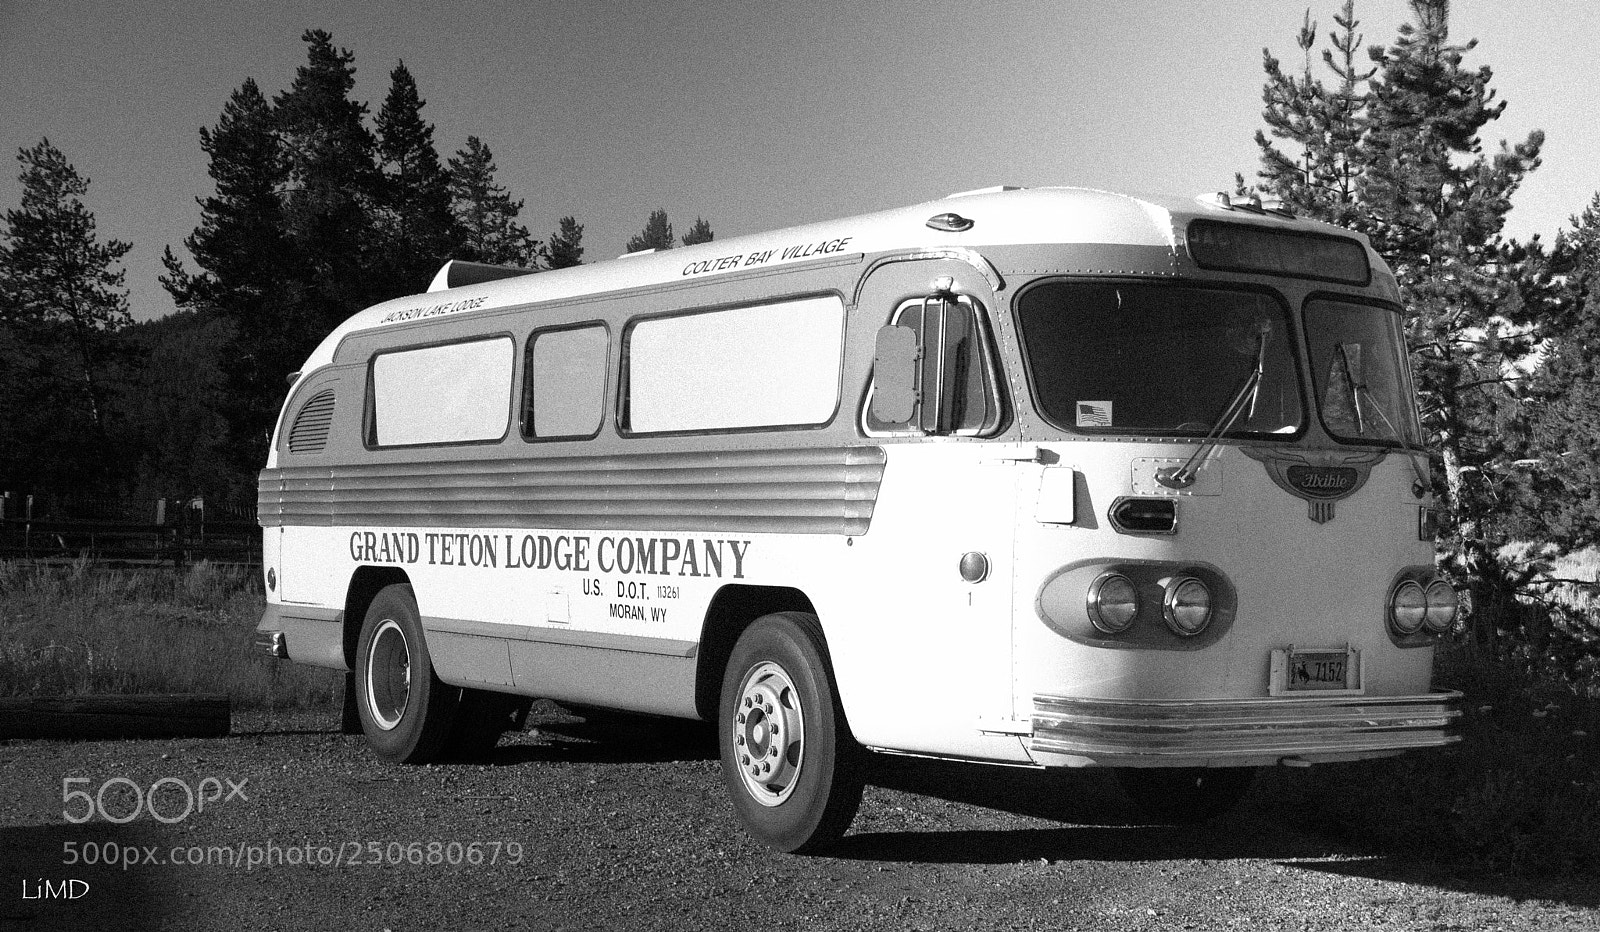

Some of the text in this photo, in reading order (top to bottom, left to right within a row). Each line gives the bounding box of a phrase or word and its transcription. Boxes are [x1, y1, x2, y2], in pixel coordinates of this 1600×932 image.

[682, 237, 853, 276] COLTER BAY VILLAGE
[423, 302, 452, 317] LAKE
[450, 296, 489, 313] LODGE
[350, 531, 751, 579] GRAND TETON LODGE COMPANY
[583, 578, 680, 600] U.S. D.O.T. 113261
[609, 603, 667, 624] MORAN, WY
[1315, 662, 1342, 682] 7152
